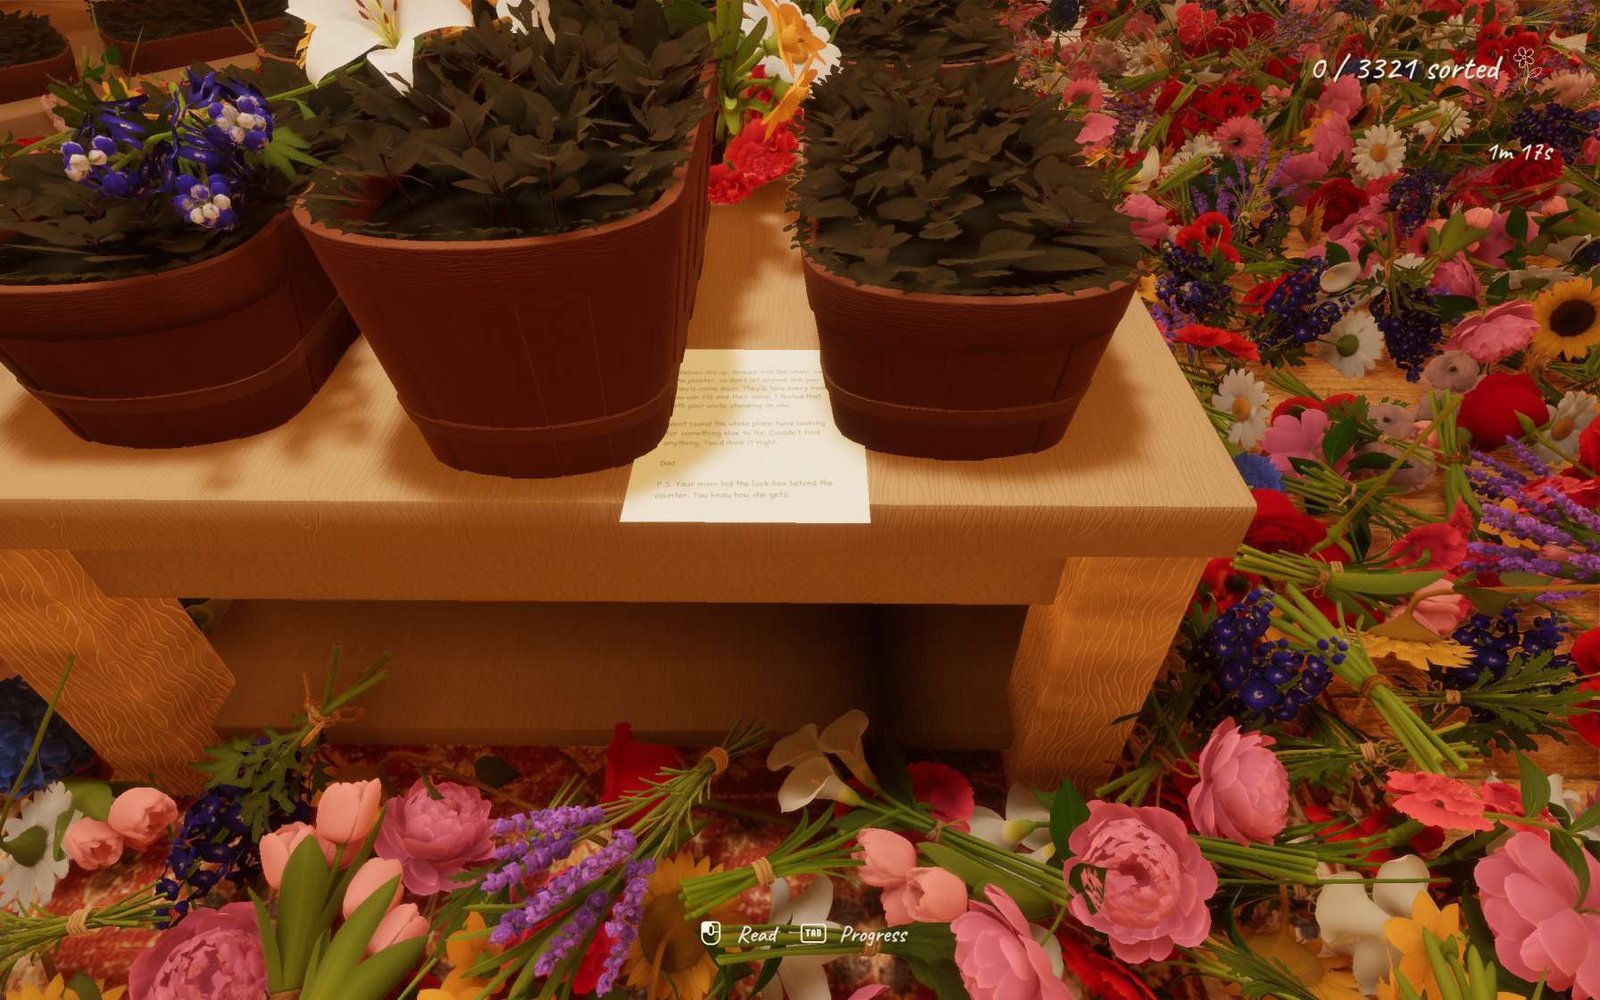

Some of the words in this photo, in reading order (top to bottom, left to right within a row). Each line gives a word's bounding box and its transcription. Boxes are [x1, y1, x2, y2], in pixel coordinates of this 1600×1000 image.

[680, 430, 722, 438] something
[693, 491, 709, 499] You
[711, 491, 732, 499] know
[734, 491, 751, 499] how
[752, 491, 767, 499] she
